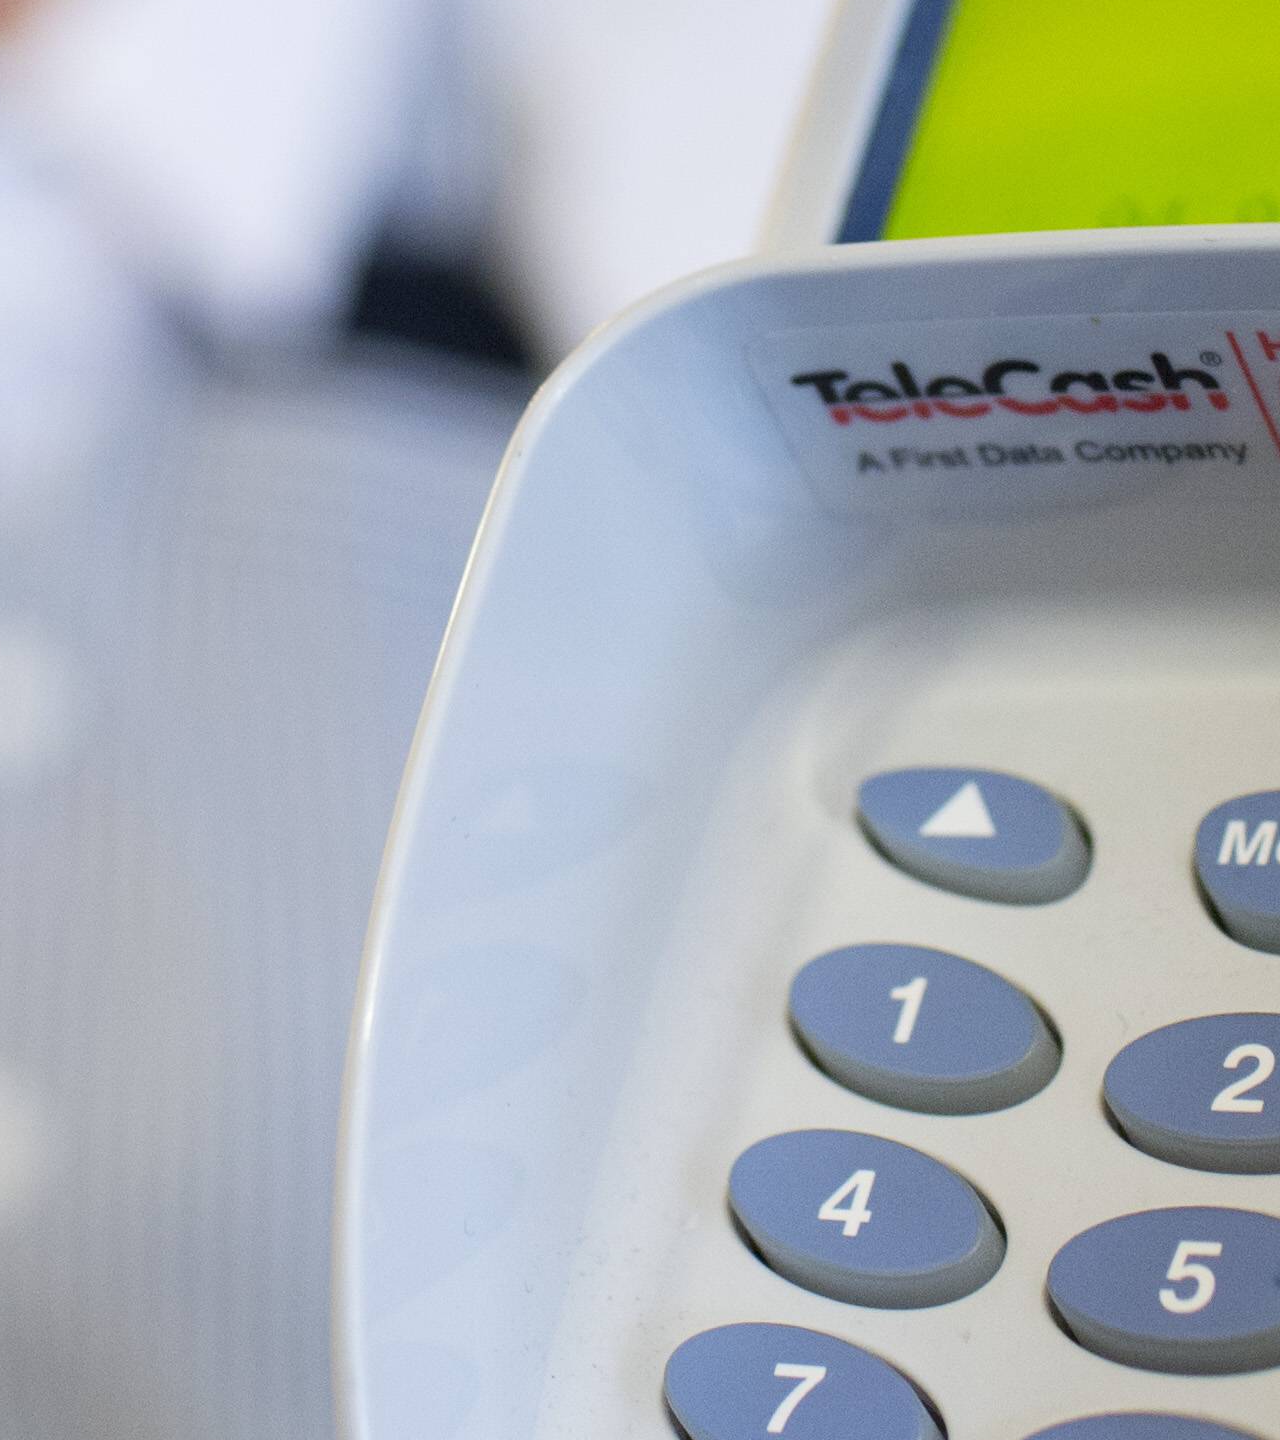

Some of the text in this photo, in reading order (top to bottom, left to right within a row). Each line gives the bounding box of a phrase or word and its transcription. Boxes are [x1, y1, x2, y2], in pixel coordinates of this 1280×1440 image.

[856, 438, 1249, 475] A First Data Company
[890, 976, 928, 1045] 1
[1209, 1042, 1276, 1114] 2
[816, 1168, 877, 1238] 4
[1158, 1239, 1224, 1315] 5
[765, 1362, 828, 1435] 7
